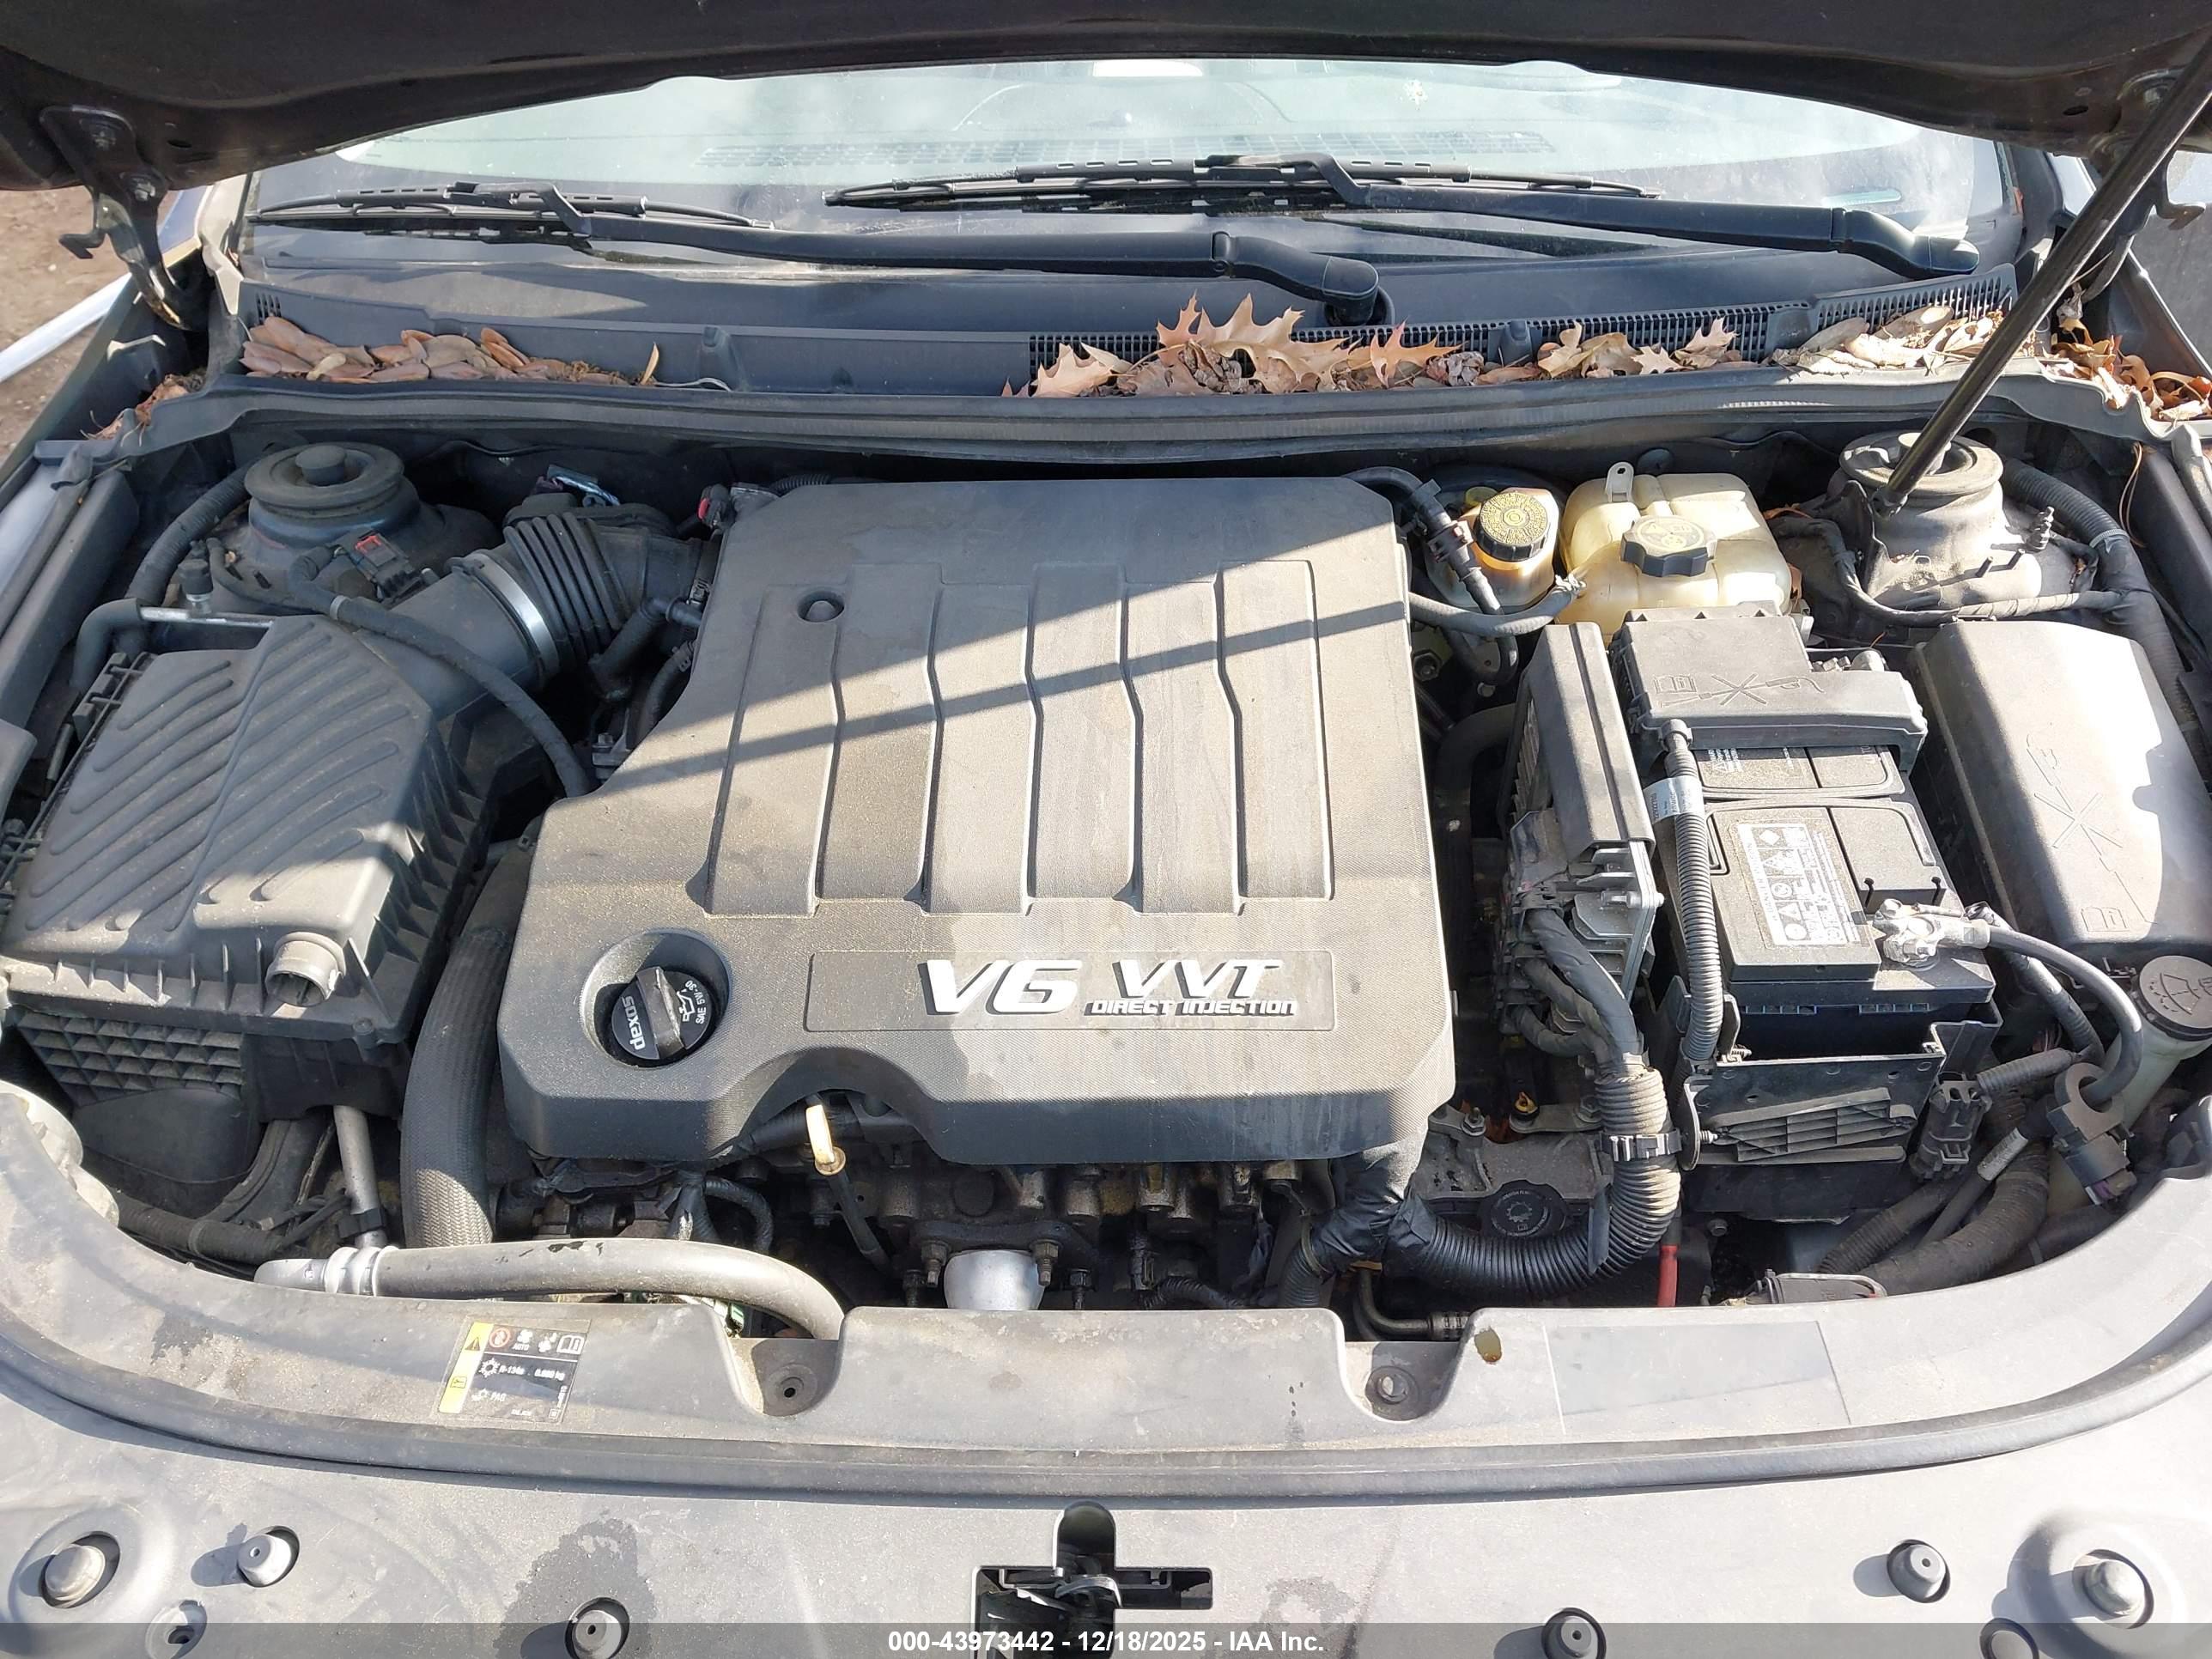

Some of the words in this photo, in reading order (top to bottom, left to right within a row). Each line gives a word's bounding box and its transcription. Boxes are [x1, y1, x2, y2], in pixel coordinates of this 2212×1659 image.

[685, 980, 705, 1006] 5W-30
[919, 959, 1083, 1015] V6
[1114, 959, 1284, 999] VVT
[696, 1006, 706, 1024] SAE
[1086, 1000, 1173, 1016] DIRECT
[1176, 1000, 1298, 1016] INJECTION
[622, 996, 646, 1050] dexos
